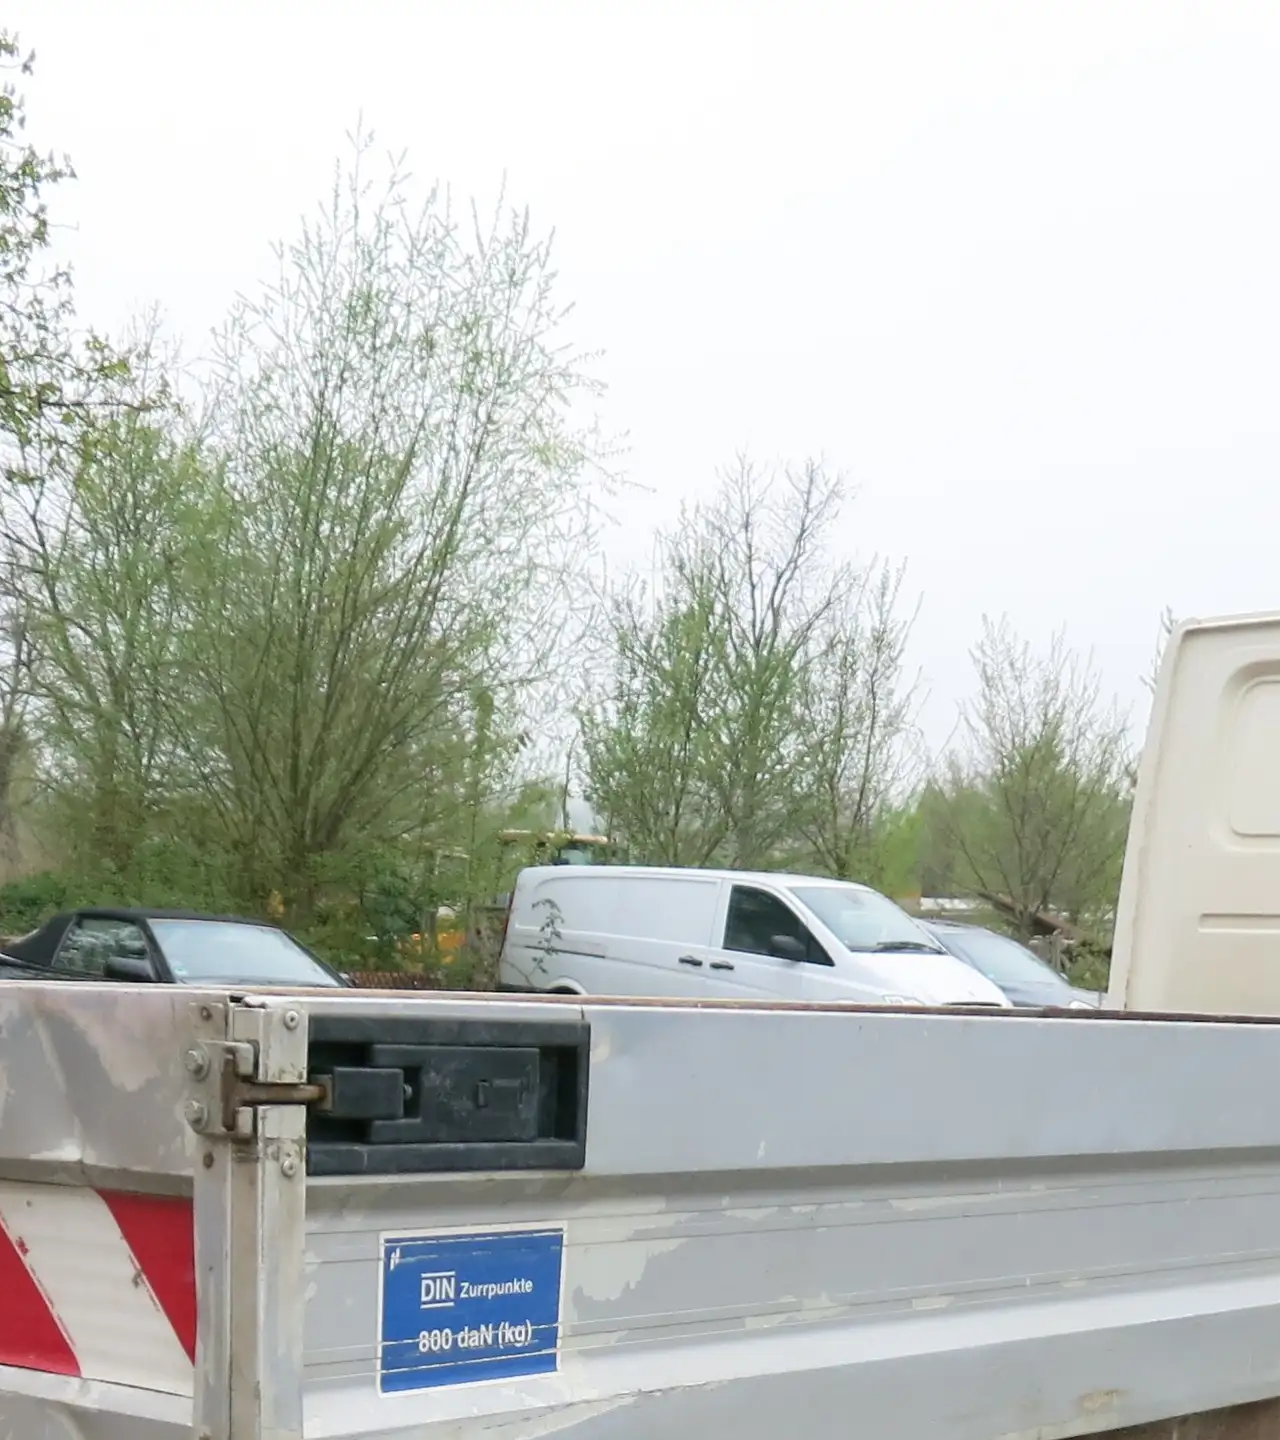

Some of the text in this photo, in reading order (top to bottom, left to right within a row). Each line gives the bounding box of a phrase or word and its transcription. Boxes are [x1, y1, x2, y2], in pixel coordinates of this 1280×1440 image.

[420, 1275, 533, 1304] DIN Zurrpunkte
[418, 1319, 533, 1353] 800 daN (kg)
